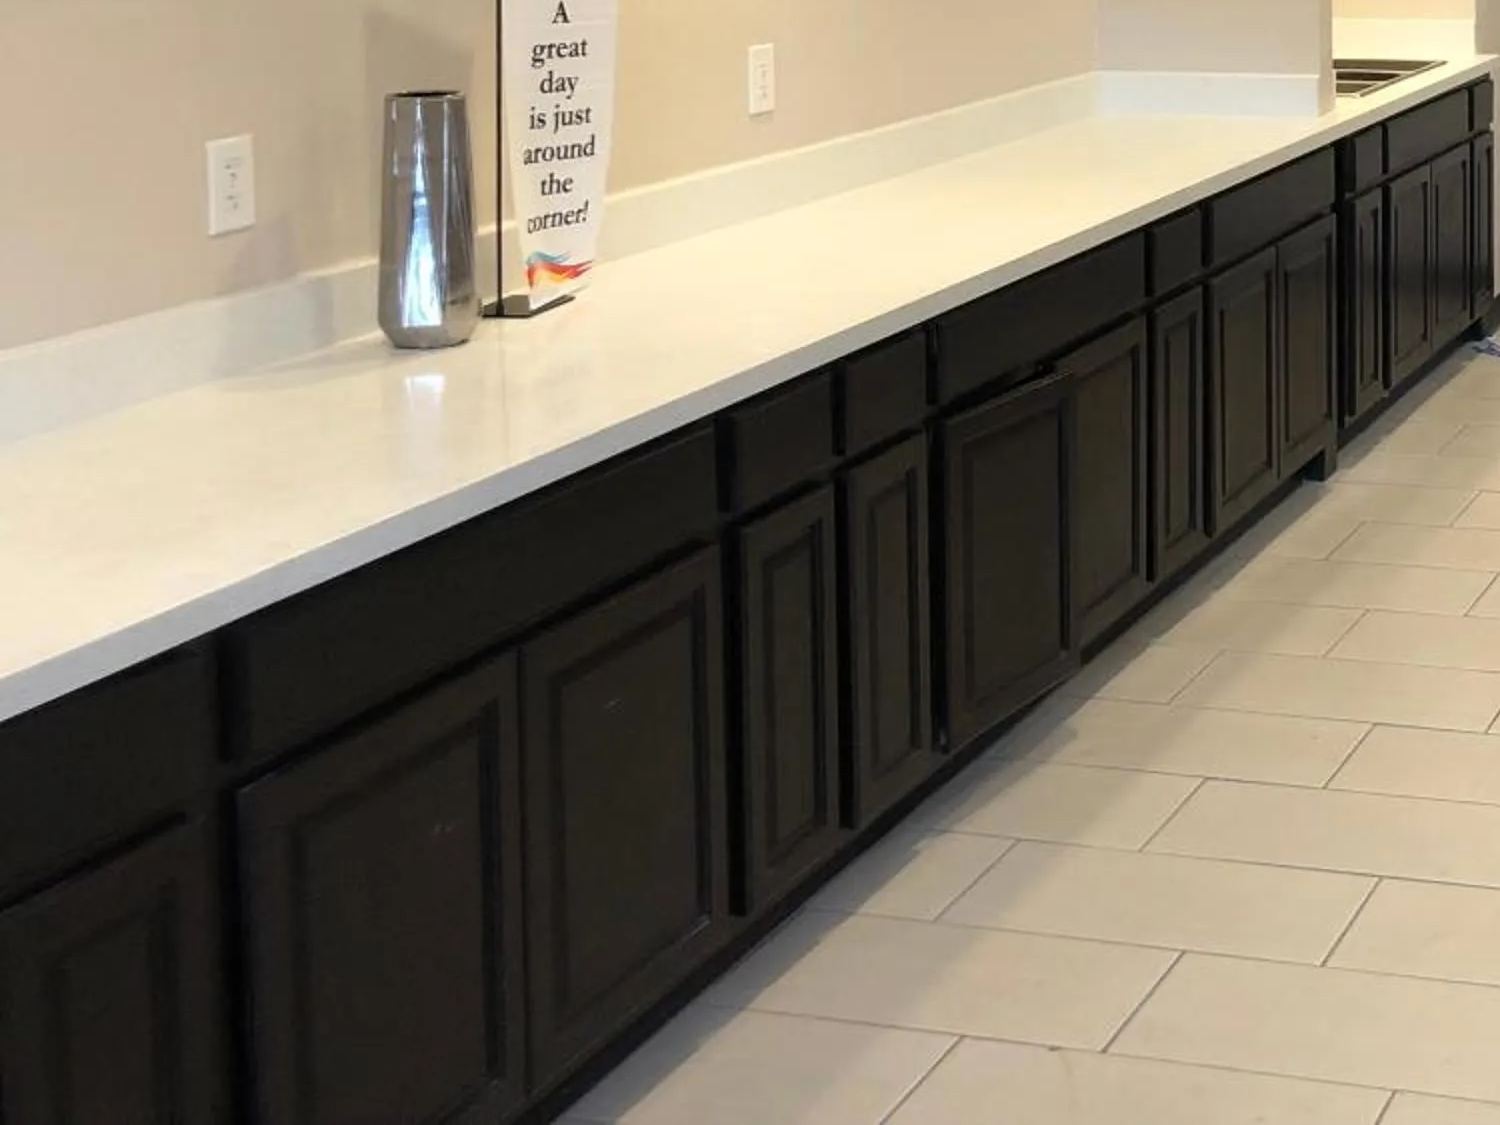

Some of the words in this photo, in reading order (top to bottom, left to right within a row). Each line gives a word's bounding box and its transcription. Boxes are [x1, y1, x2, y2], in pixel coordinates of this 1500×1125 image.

[551, 0, 571, 24] A
[531, 38, 588, 69] great
[539, 70, 579, 100] day
[529, 106, 547, 131] is
[553, 103, 592, 135] just
[523, 134, 595, 166] around
[540, 172, 574, 197] the
[527, 198, 590, 235] corner!
